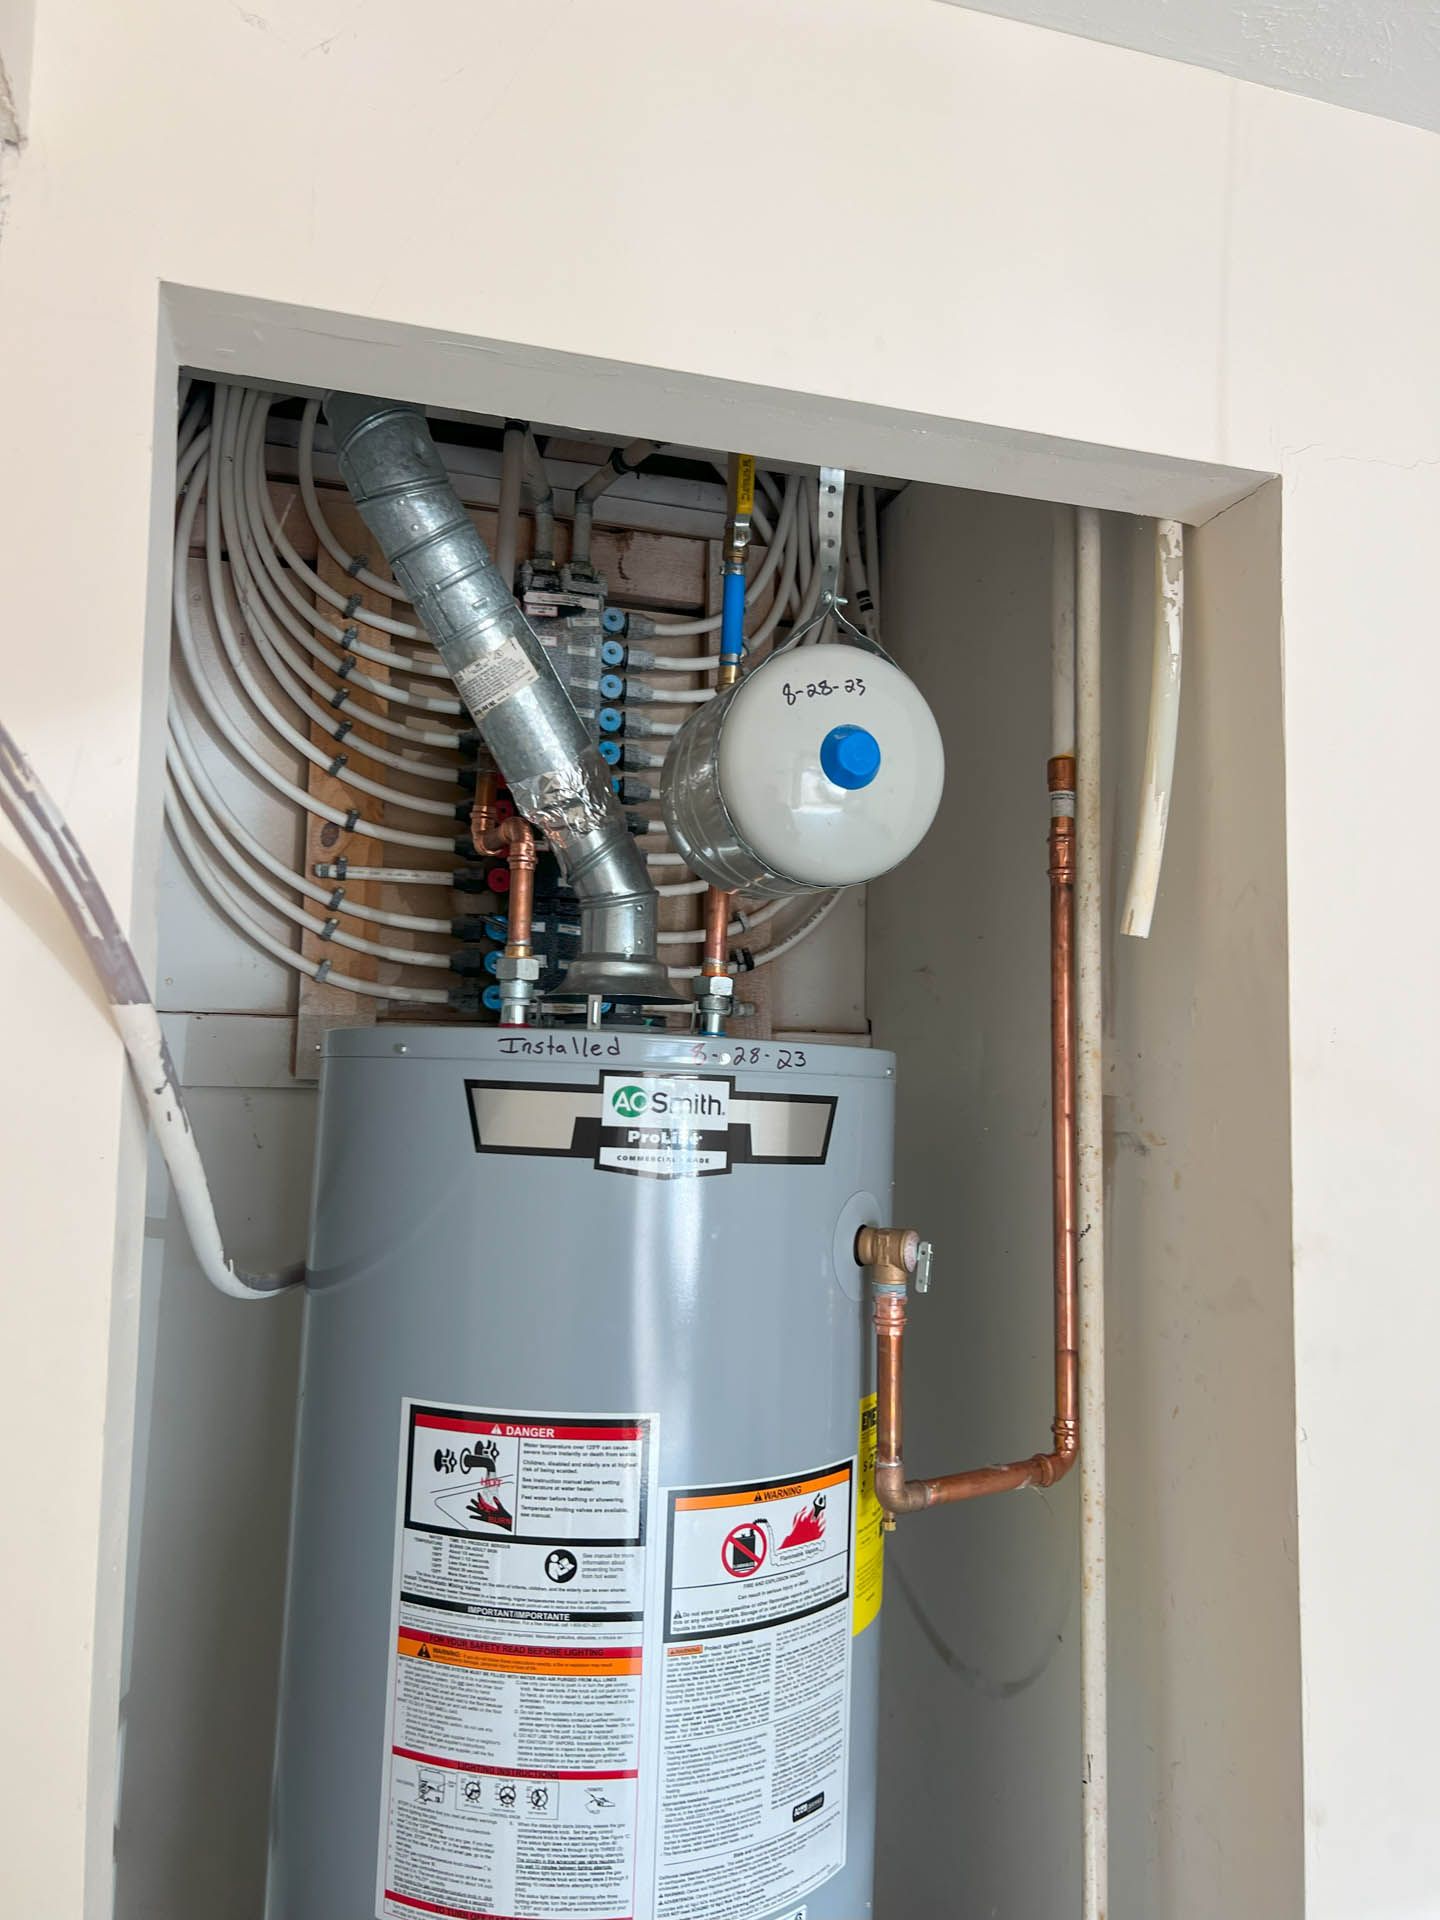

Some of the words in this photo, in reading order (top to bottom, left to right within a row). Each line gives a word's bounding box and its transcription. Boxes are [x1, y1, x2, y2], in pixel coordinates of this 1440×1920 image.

[782, 678, 866, 706] 8-28-23
[498, 1036, 620, 1056] Installed
[506, 1426, 554, 1438] DANGER
[764, 1486, 802, 1500] WARNING
